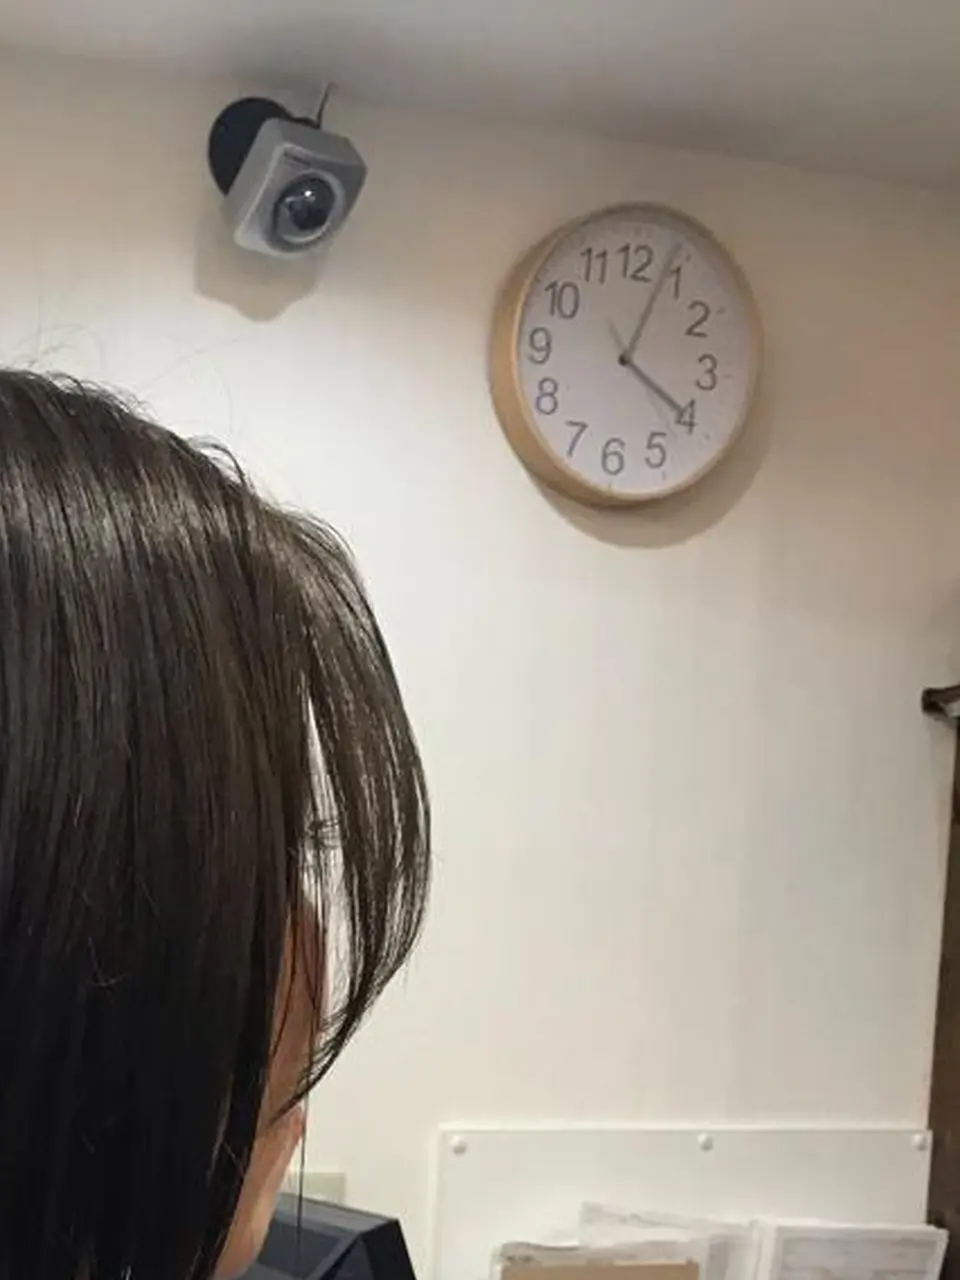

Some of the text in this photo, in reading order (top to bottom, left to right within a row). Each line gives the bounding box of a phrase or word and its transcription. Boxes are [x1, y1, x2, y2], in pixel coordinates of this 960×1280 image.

[580, 247, 608, 285] 11
[616, 243, 654, 284] 12
[544, 280, 580, 319] 10
[669, 266, 683, 300] 1
[685, 301, 711, 338] 2
[528, 327, 552, 365] 9
[695, 353, 718, 391] 3
[535, 377, 559, 415] 8
[675, 398, 697, 435] 4
[565, 420, 588, 458] 7
[601, 437, 625, 476] 6
[644, 433, 667, 469] 5
